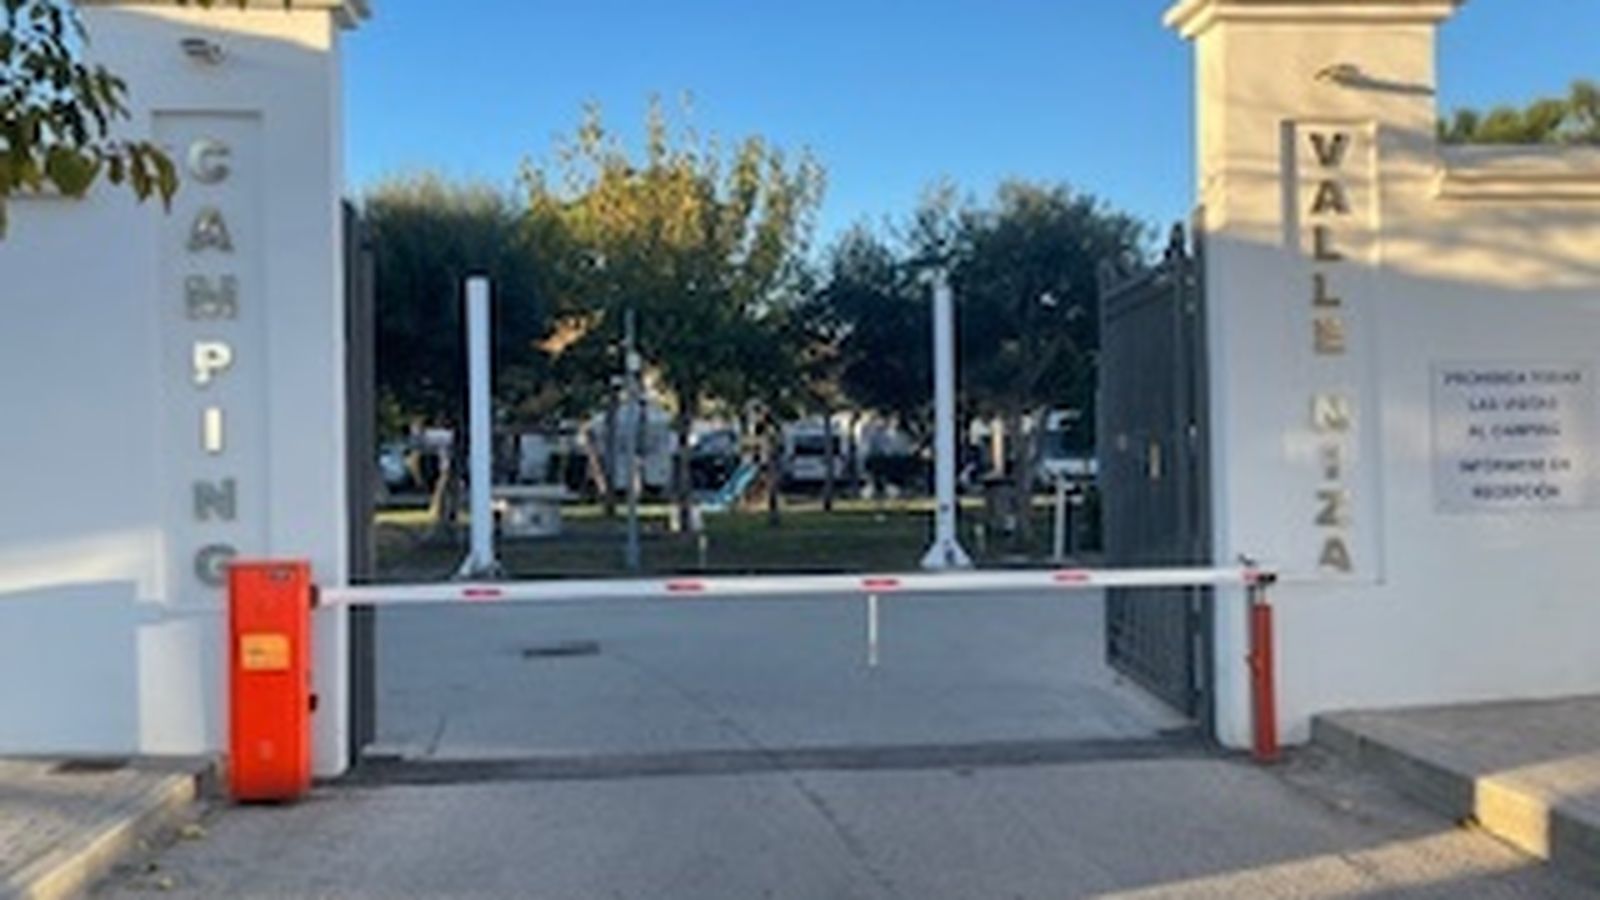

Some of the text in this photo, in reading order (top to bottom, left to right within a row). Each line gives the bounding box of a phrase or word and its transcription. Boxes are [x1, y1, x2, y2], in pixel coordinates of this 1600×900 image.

[186, 137, 239, 588] CAMPING
[1309, 132, 1354, 573] VALLE NIZA
